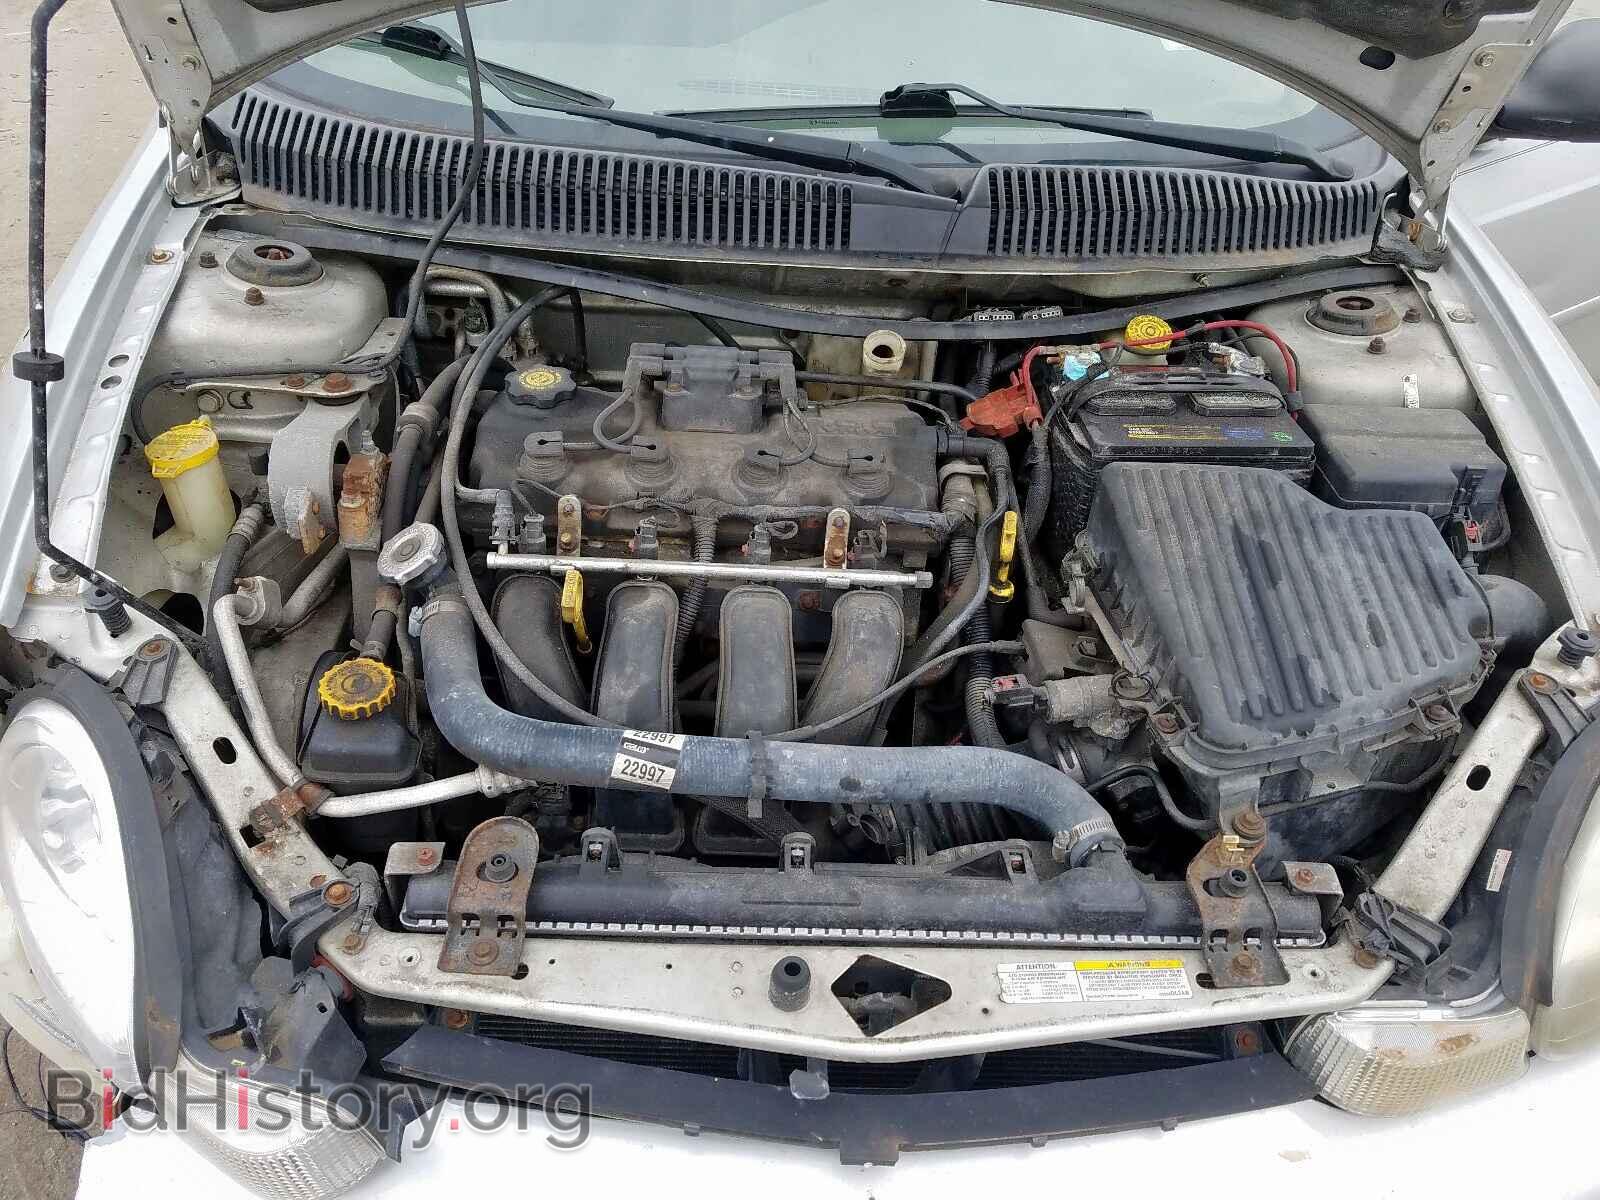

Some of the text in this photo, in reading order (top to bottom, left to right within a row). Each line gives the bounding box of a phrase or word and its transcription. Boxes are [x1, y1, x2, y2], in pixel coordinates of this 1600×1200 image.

[633, 730, 675, 744] 22997
[621, 759, 665, 782] 22997
[1016, 963, 1056, 971] ATTENTION
